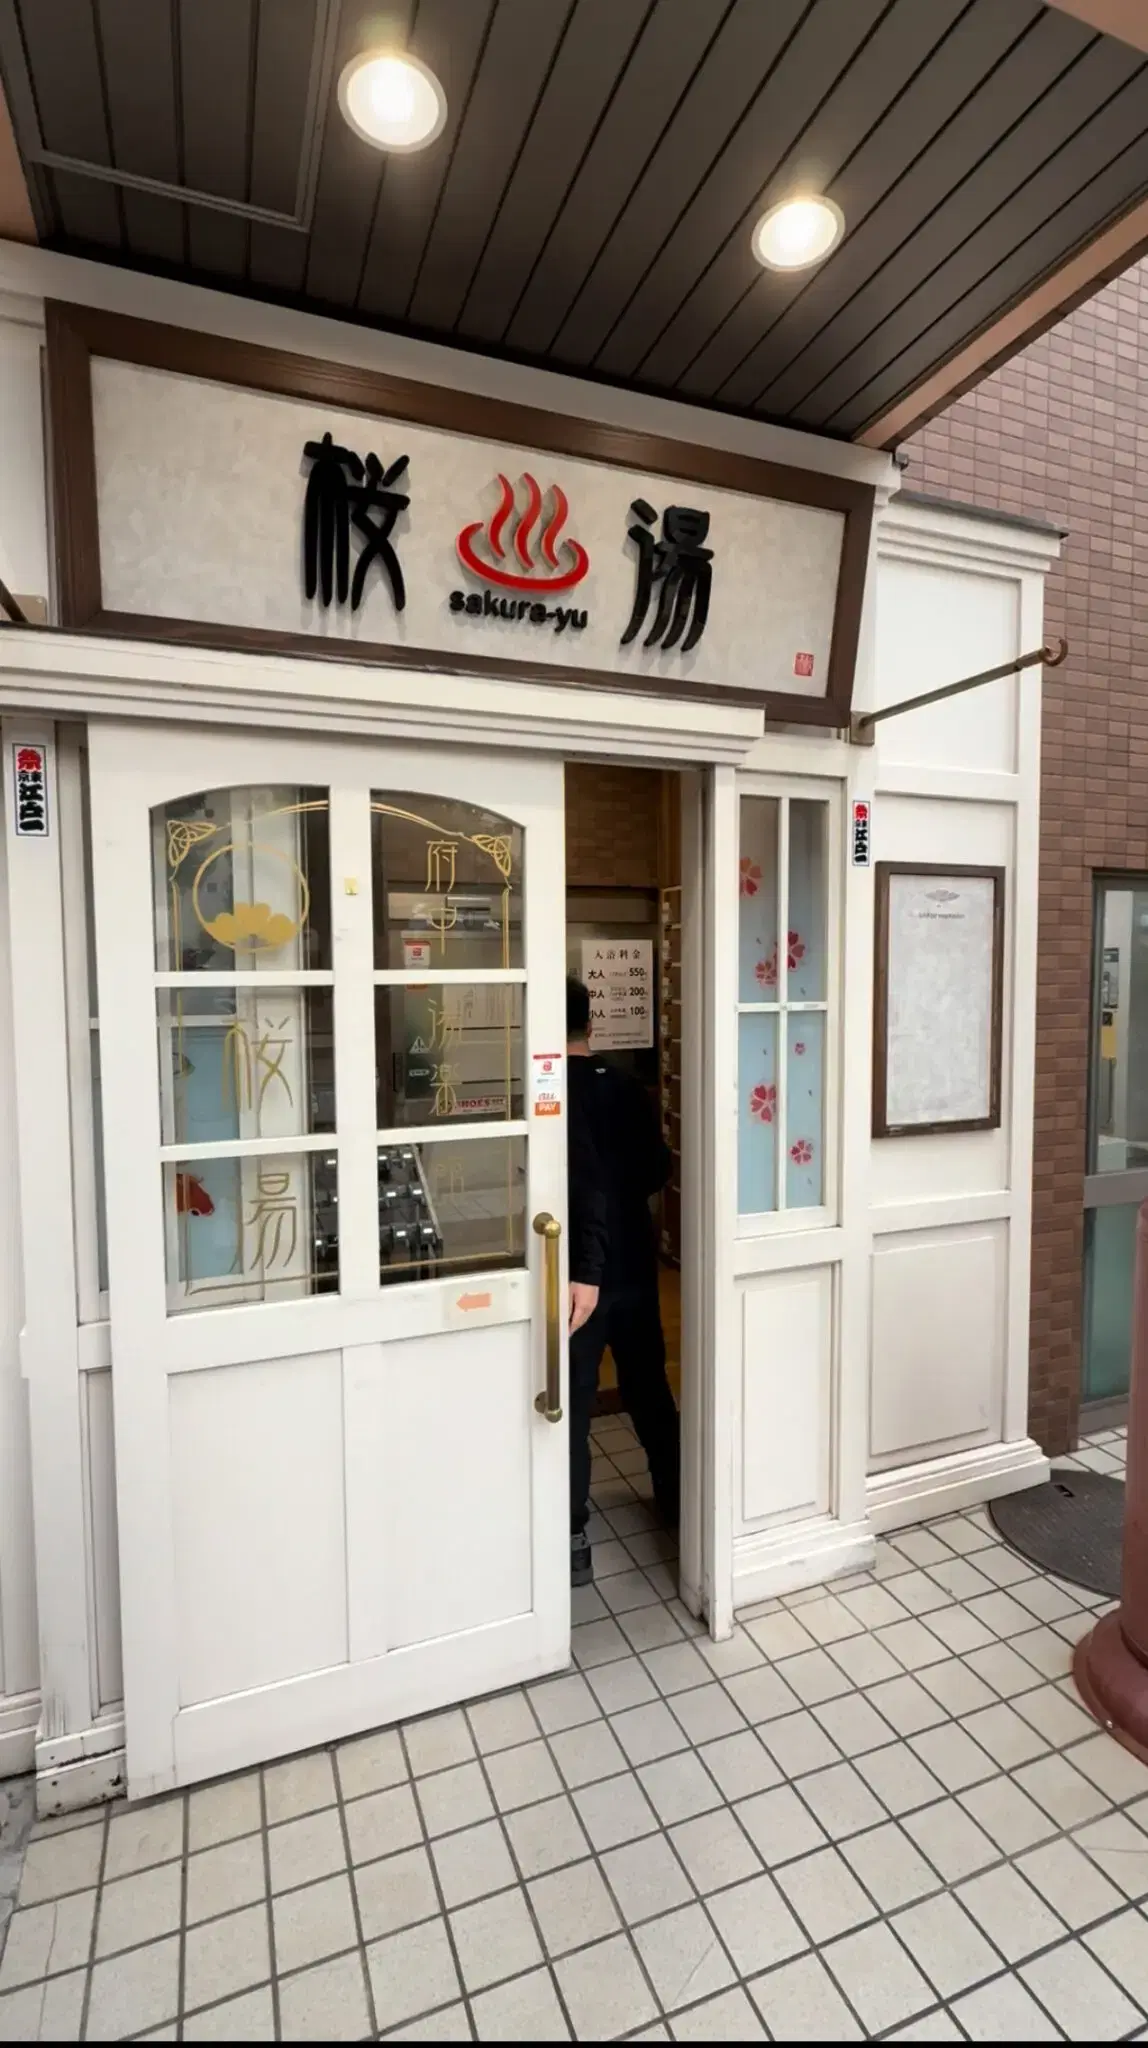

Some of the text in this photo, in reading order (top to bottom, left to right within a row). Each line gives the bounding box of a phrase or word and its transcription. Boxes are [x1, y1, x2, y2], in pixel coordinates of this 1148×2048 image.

[303, 431, 714, 652] 桜 湯
[448, 588, 590, 632] sakura-yu
[587, 969, 605, 980] 大人
[629, 987, 645, 997] 200
[630, 1006, 645, 1016] 100
